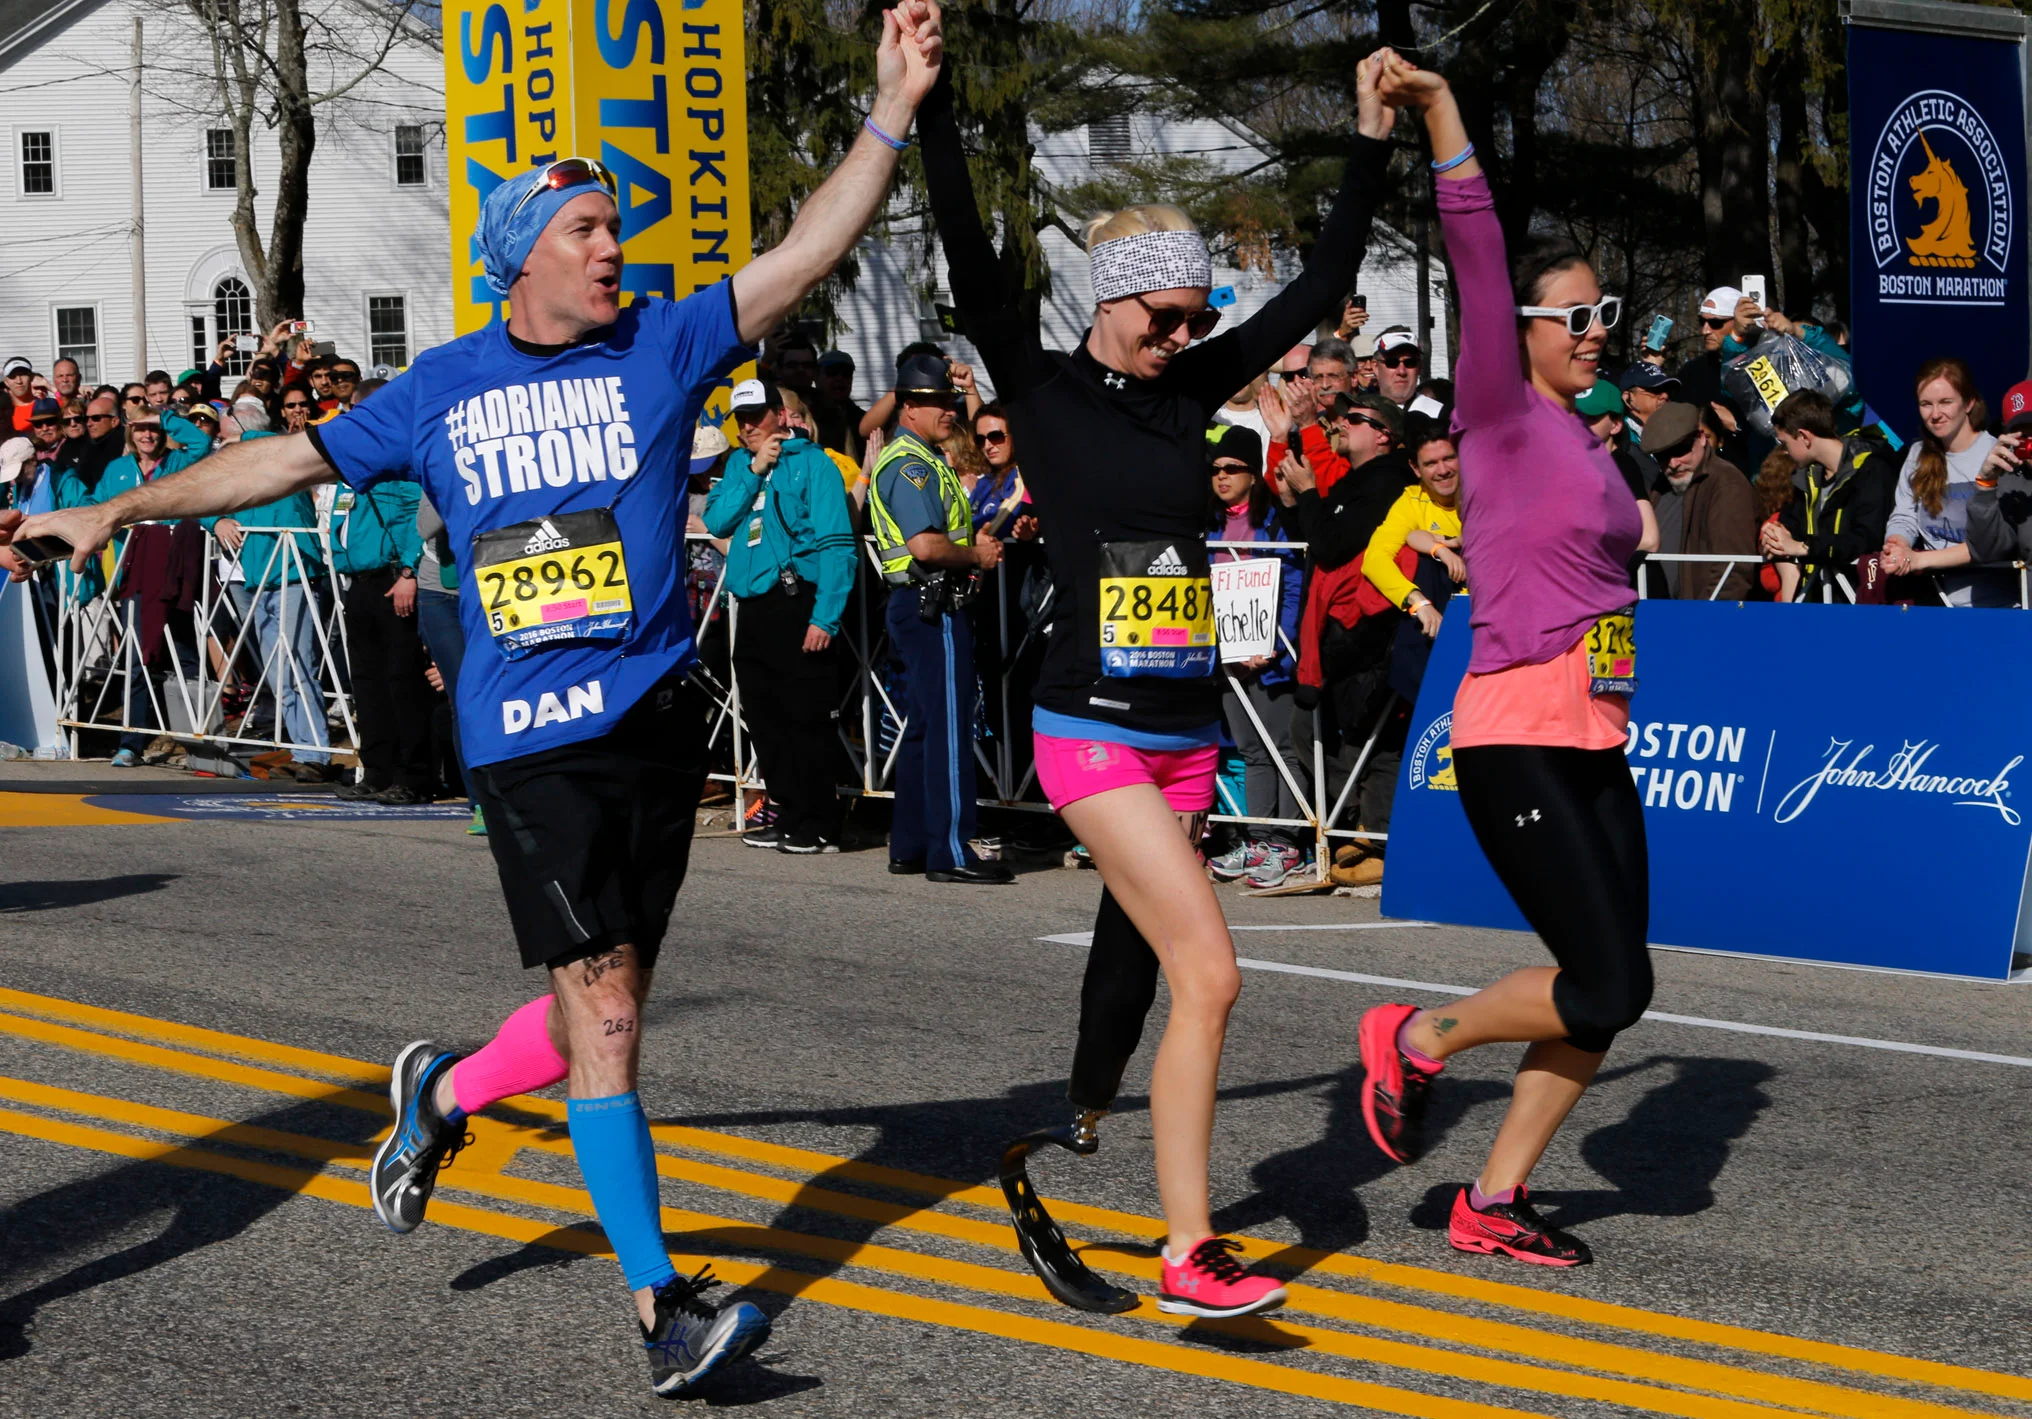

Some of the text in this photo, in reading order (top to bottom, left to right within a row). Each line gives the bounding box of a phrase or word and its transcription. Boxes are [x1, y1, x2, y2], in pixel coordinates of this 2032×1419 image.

[1873, 98, 2008, 256] BOSTON ATHLETIC ASSOCIATION
[1879, 274, 2005, 297] BOSTON MARATHON
[1748, 361, 1779, 406] 2961
[444, 376, 630, 451] #ADRIANNE
[454, 421, 639, 505] STRONG
[524, 537, 571, 555] adidas
[484, 551, 625, 610] 28962
[1147, 564, 1188, 576] adidas
[1217, 569, 1231, 592] Fi
[1236, 564, 1272, 590] Fund
[1105, 584, 1212, 621] 28487
[491, 612, 503, 632] 5
[519, 624, 573, 641] 2016 BOSTON
[1103, 624, 1115, 643] 5
[521, 632, 575, 646] MARATHON
[1129, 659, 1175, 668] MARATHON
[1147, 651, 1176, 659] BOSTON
[502, 680, 604, 735] DAN
[1412, 737, 1431, 783] BOSTON
[1773, 736, 2025, 827] John Hancock
